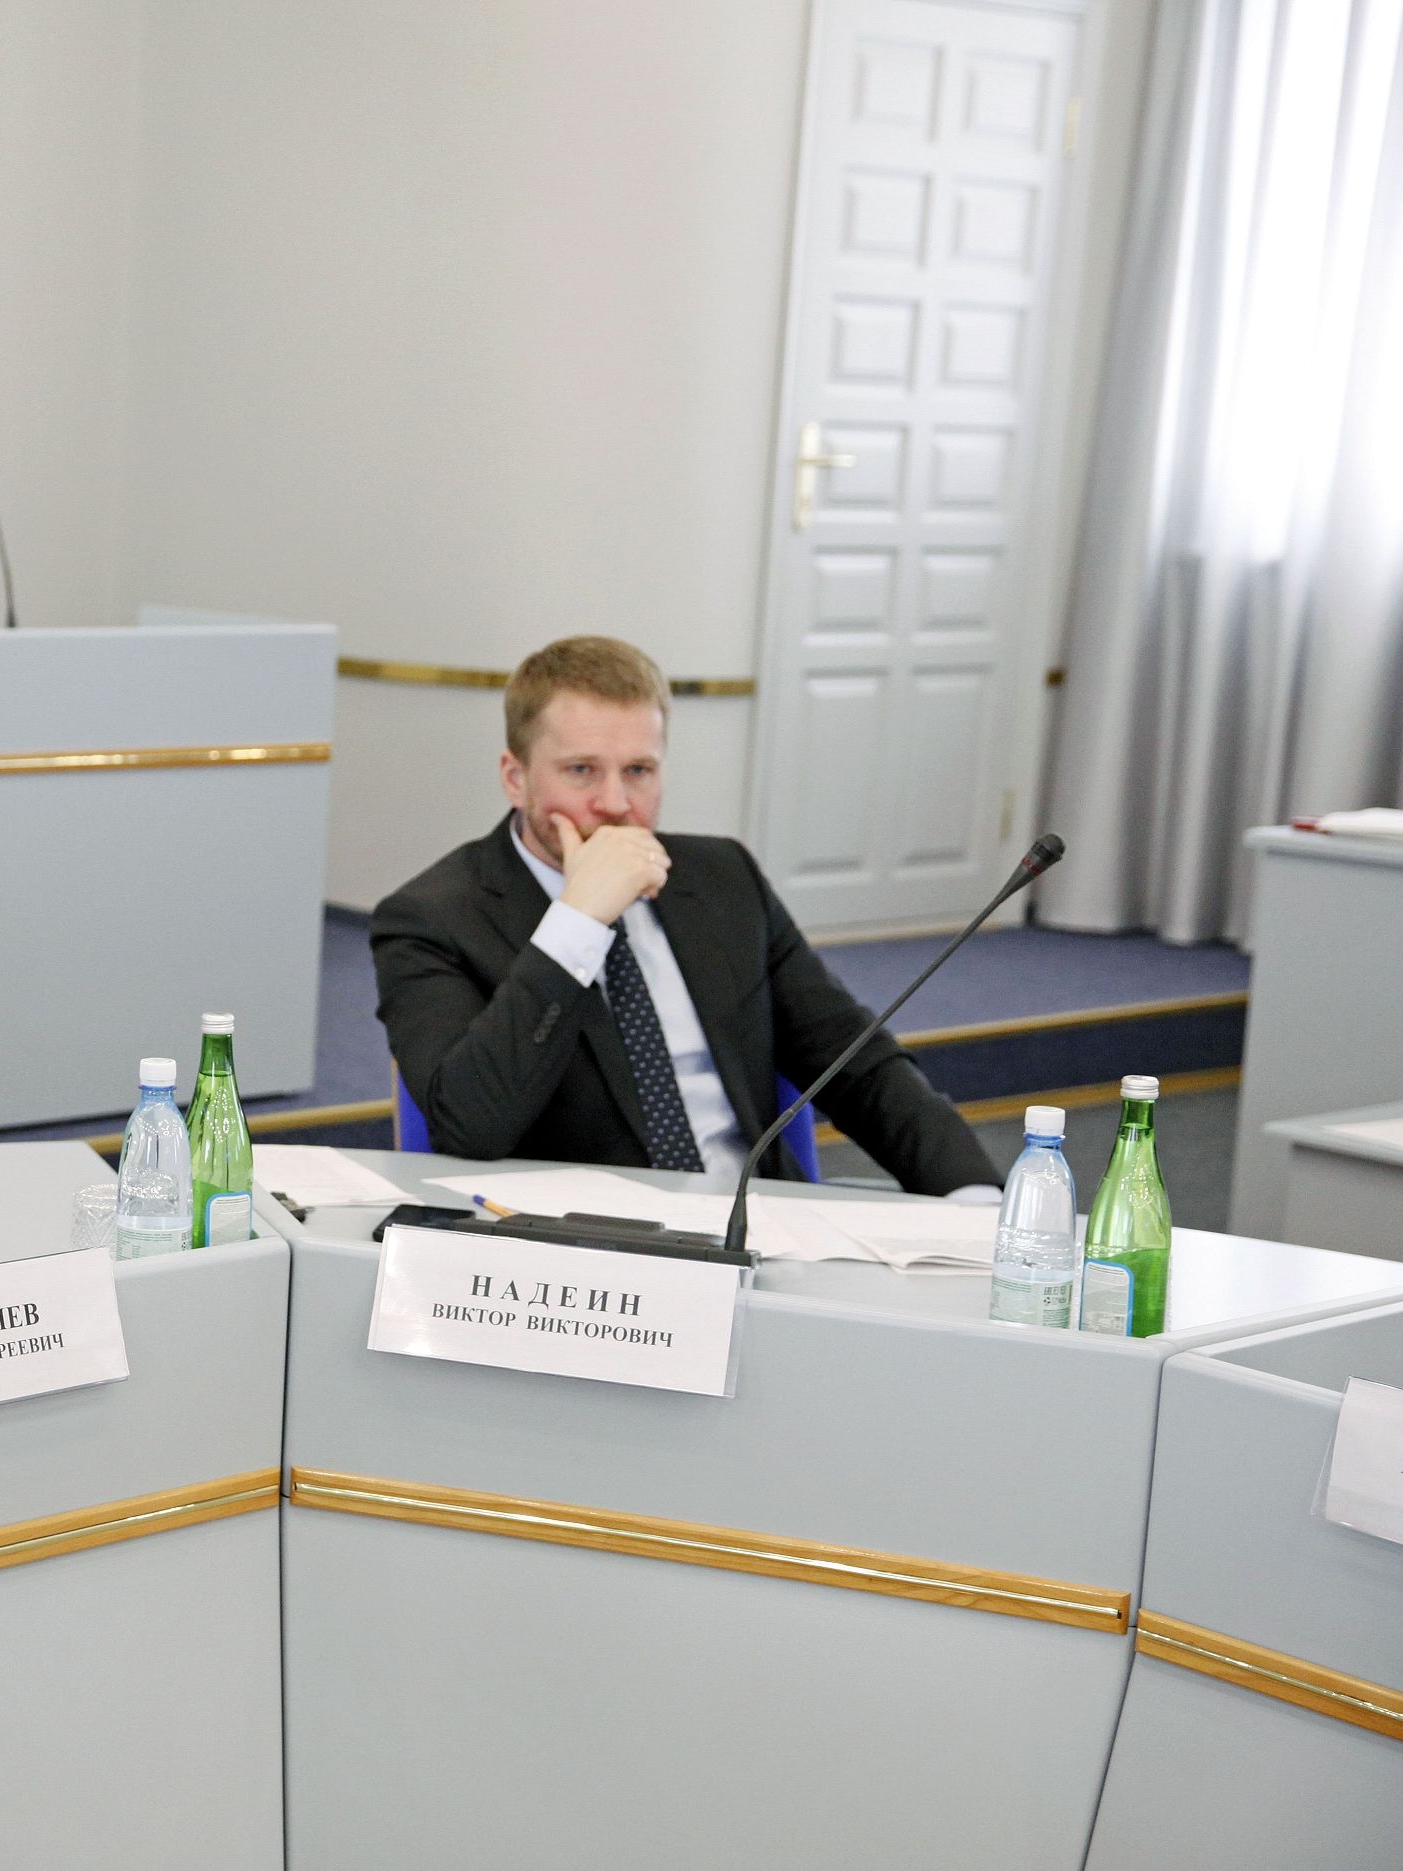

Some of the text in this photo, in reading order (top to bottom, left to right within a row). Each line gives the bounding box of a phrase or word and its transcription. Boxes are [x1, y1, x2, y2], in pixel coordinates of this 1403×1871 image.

[470, 1274, 642, 1317] НАДЕИН
[432, 1303, 674, 1348] ВИКТОР ВИКТОРОВИЧ
